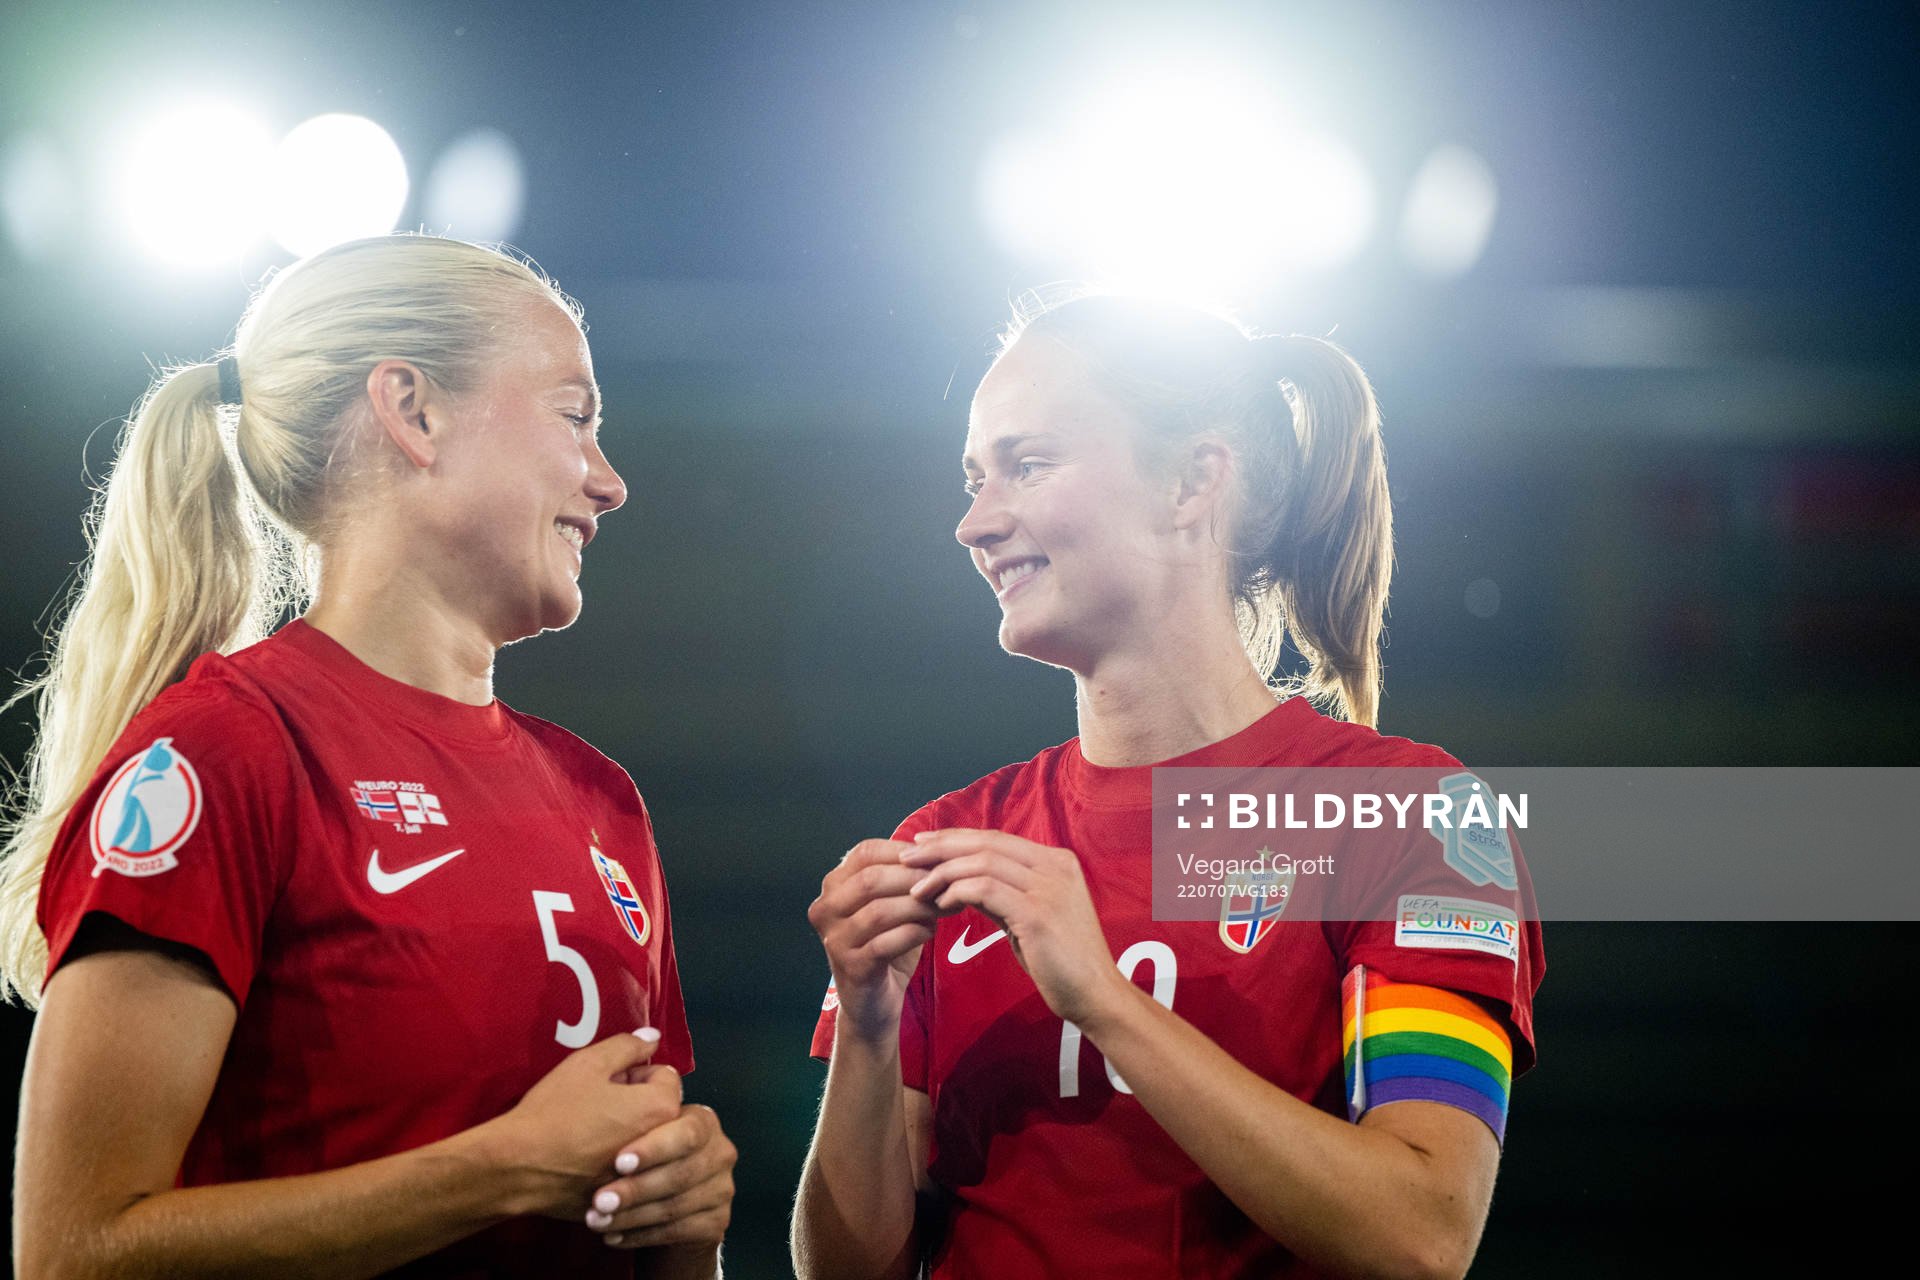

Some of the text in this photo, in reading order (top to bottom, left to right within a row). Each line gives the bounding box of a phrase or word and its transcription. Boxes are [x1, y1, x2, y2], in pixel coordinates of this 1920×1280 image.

[398, 781, 426, 793] 2022
[133, 857, 165, 872] 2022
[1402, 897, 1440, 910] UEFA
[531, 889, 600, 1049] 5
